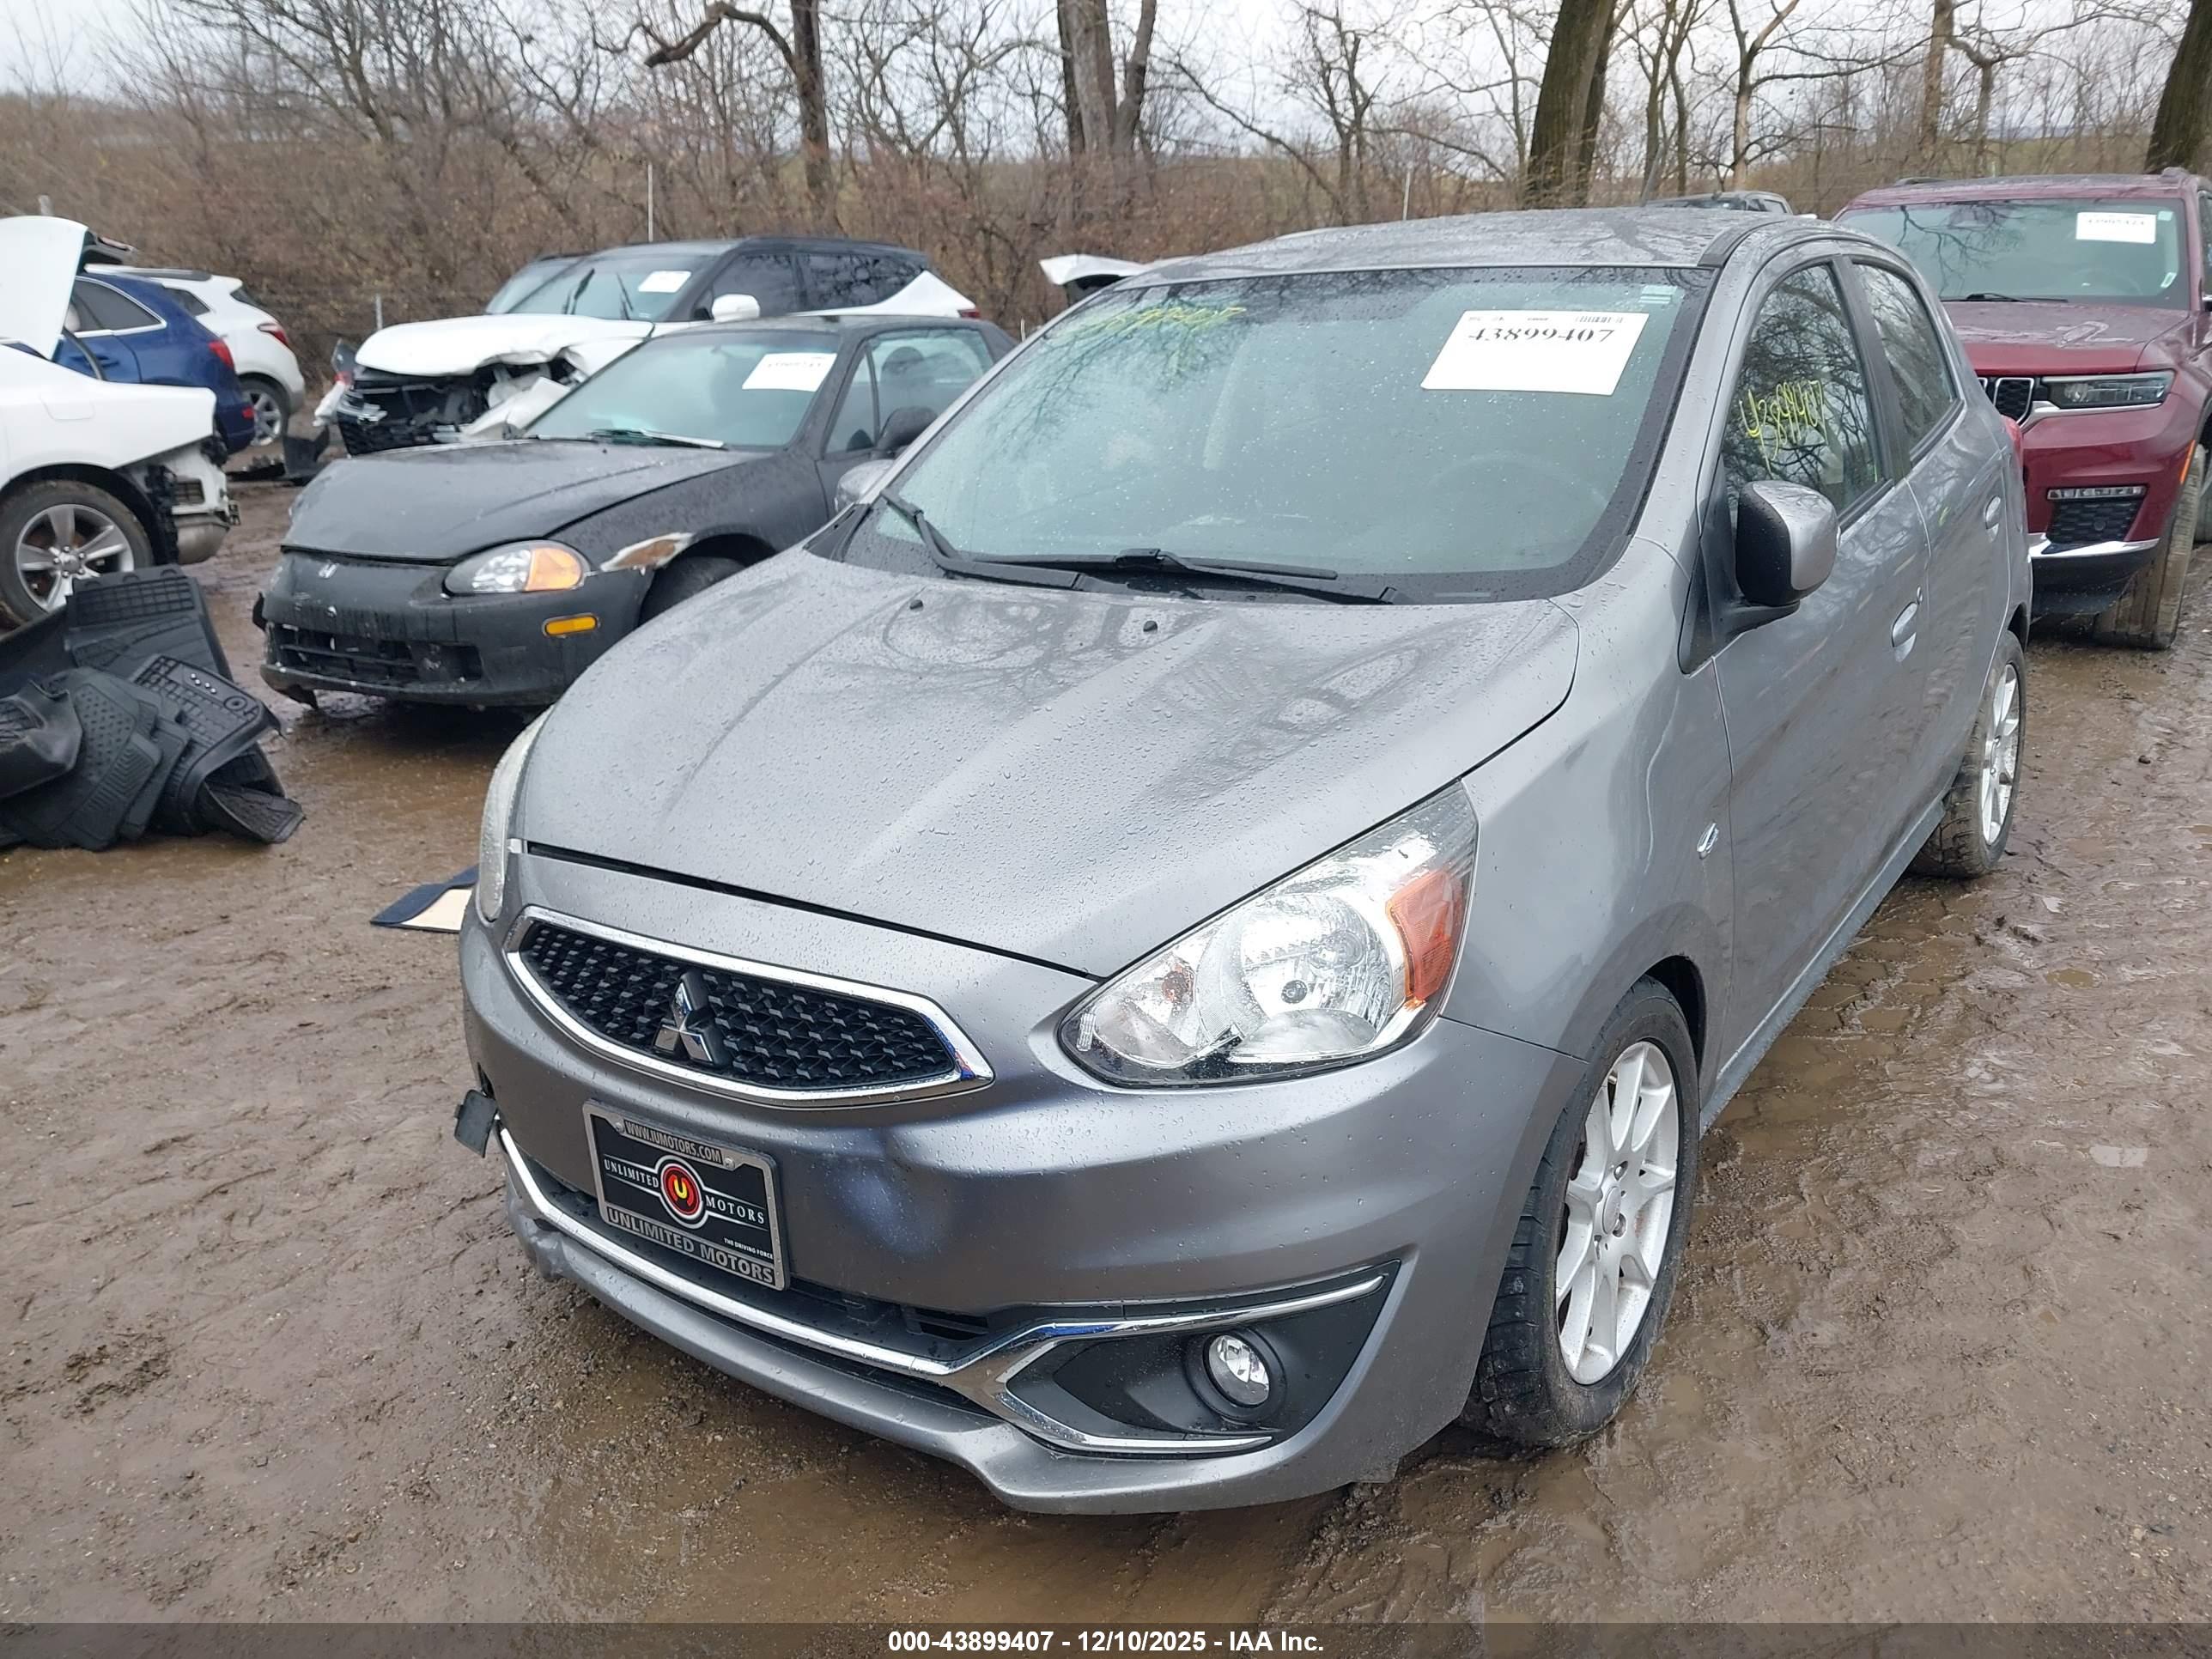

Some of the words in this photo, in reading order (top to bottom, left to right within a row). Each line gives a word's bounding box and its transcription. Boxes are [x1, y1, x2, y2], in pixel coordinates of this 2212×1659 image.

[1467, 327, 1615, 342] 43899407
[625, 1121, 722, 1164] WWW.IUMOTORS.COM
[604, 1158, 659, 1188] UNLIMITED
[705, 1194, 765, 1224] MOTORS
[608, 1207, 695, 1253] UNLIMITED
[700, 1244, 775, 1284] MOTORS
[723, 1237, 734, 1246] THE
[734, 1241, 757, 1254] DRIVING
[756, 1249, 774, 1260] FORCE
